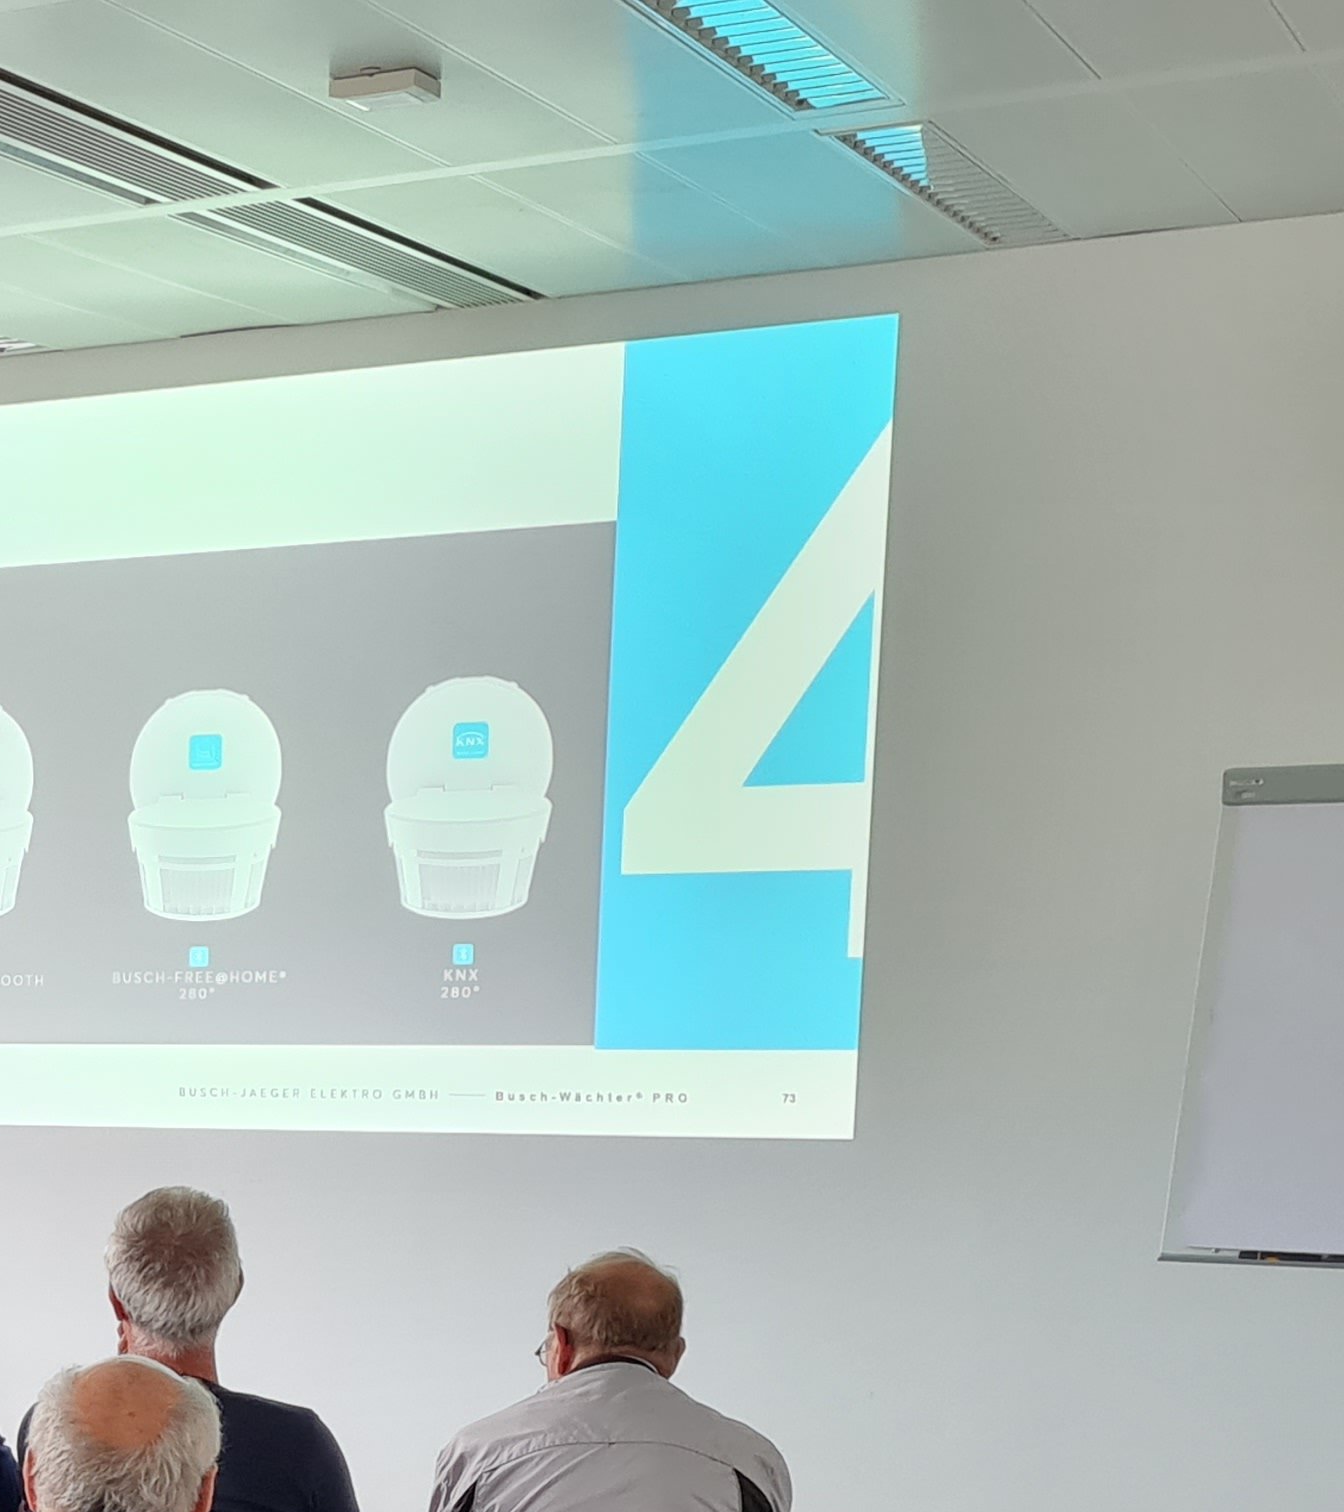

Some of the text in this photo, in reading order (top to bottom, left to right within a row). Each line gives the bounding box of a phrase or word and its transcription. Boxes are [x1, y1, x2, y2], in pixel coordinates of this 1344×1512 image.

[442, 968, 480, 982] KNX
[178, 1087, 440, 1101] BUSCH-JAEGER ELEKTRO GMBH
[652, 1093, 689, 1104] PRO
[781, 1092, 797, 1104] 73
